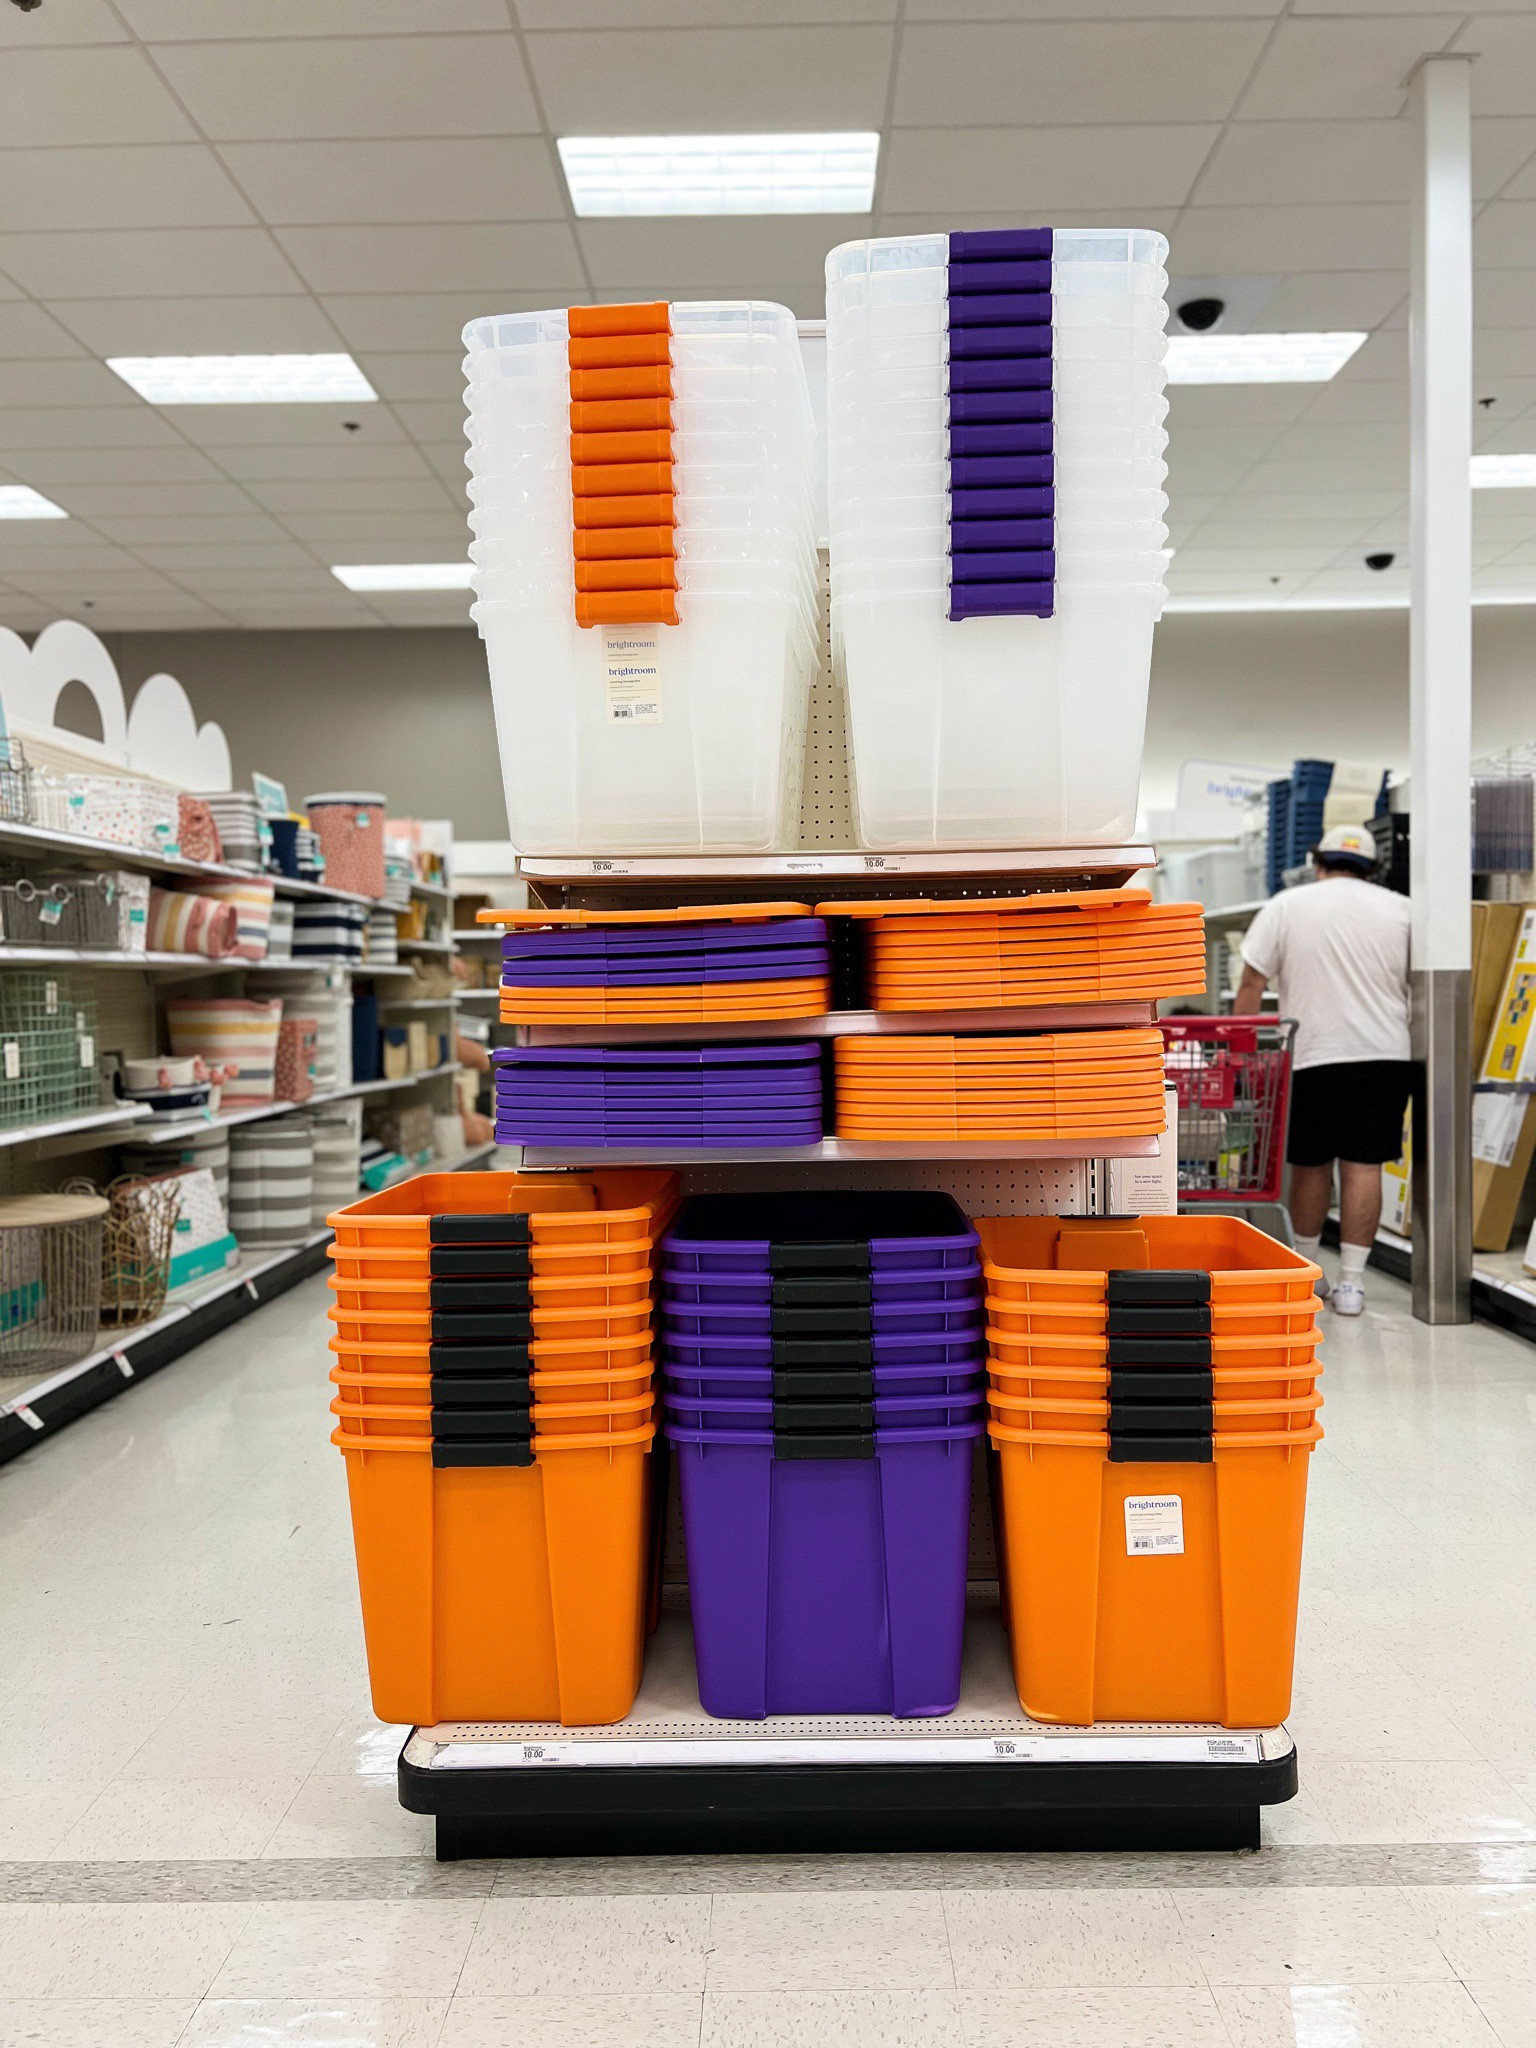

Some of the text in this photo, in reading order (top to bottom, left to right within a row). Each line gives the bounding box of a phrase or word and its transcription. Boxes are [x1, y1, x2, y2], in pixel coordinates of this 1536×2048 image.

[607, 641, 655, 650] brightroom
[608, 667, 657, 677] brightroom
[1128, 1501, 1178, 1510] brightroom
[523, 1750, 543, 1759] 10.00
[995, 1746, 1015, 1754] 10.00
